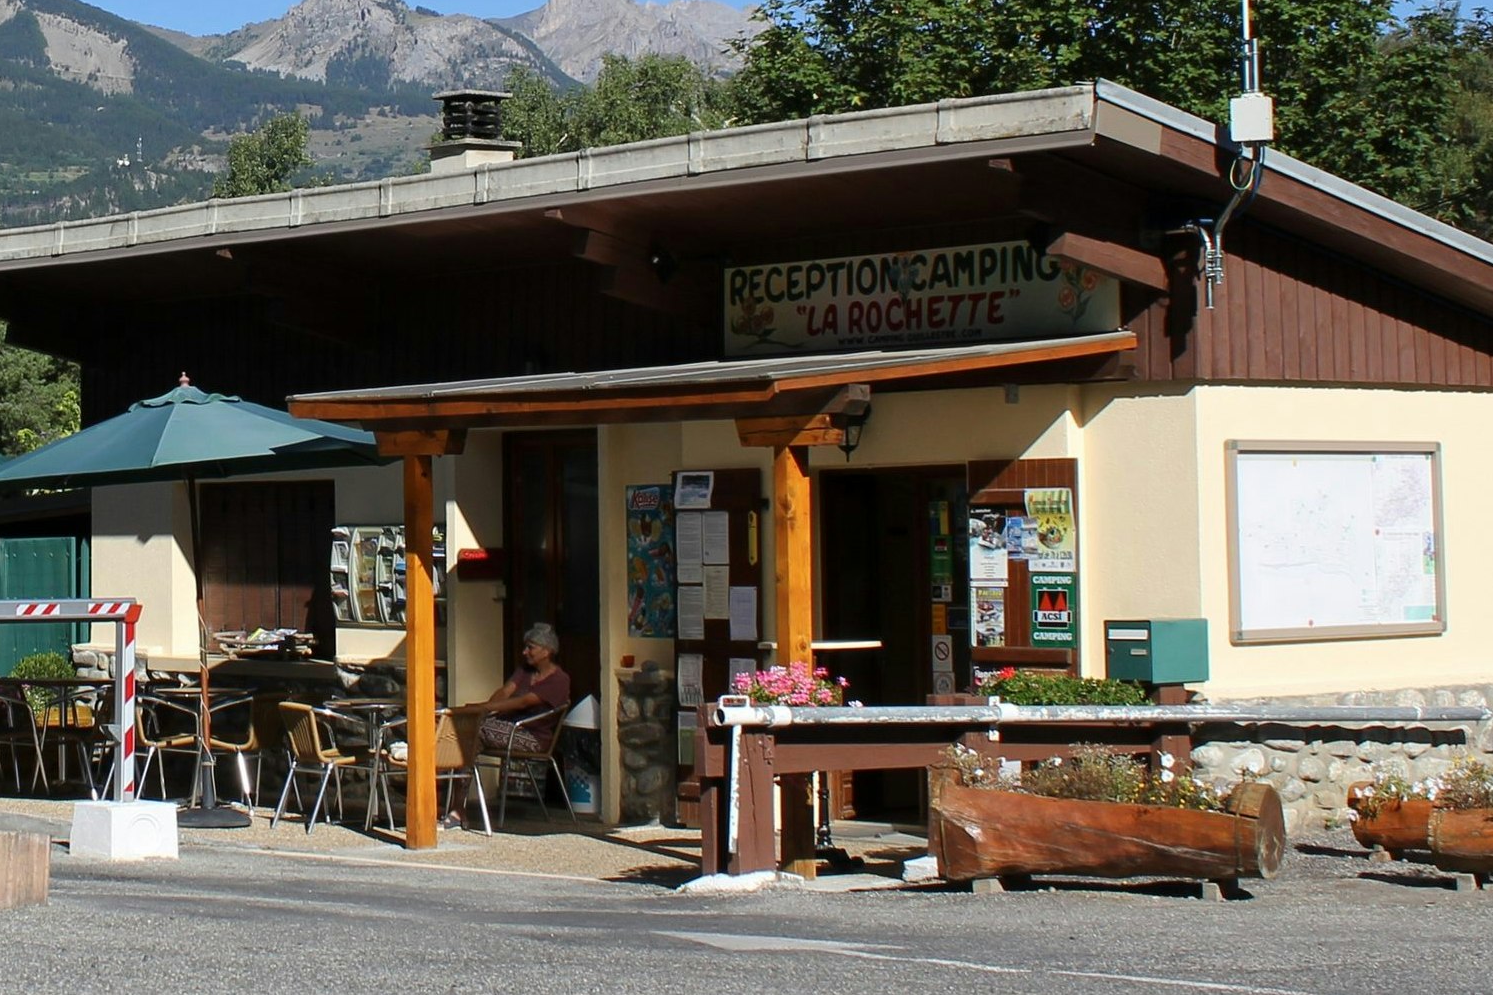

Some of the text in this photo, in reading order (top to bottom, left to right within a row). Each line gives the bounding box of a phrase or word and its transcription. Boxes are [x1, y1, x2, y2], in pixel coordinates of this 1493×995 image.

[730, 244, 1061, 305] RECEPTION CAMPING
[1032, 575, 1073, 585] CAMPING
[1033, 631, 1073, 641] CAMPING
